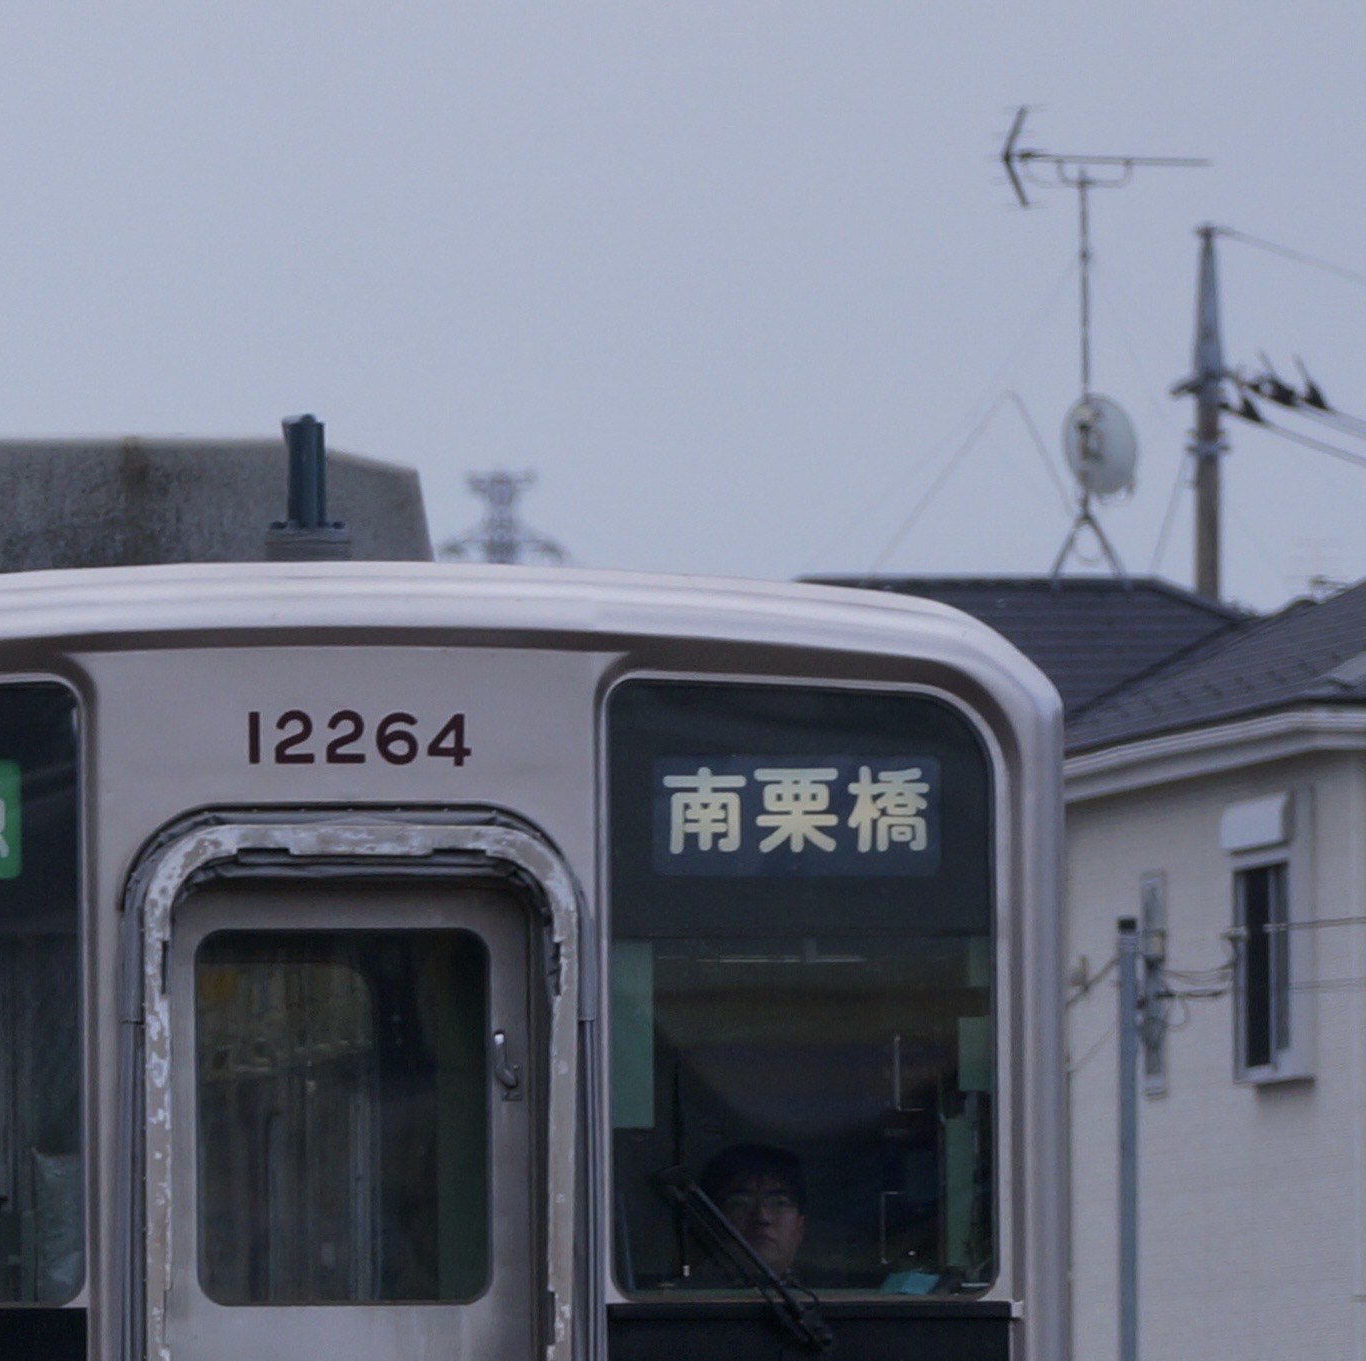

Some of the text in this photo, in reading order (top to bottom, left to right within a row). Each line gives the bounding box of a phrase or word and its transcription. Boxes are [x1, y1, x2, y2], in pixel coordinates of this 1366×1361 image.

[247, 708, 473, 767] 12264
[661, 765, 931, 855] 南栗橋
